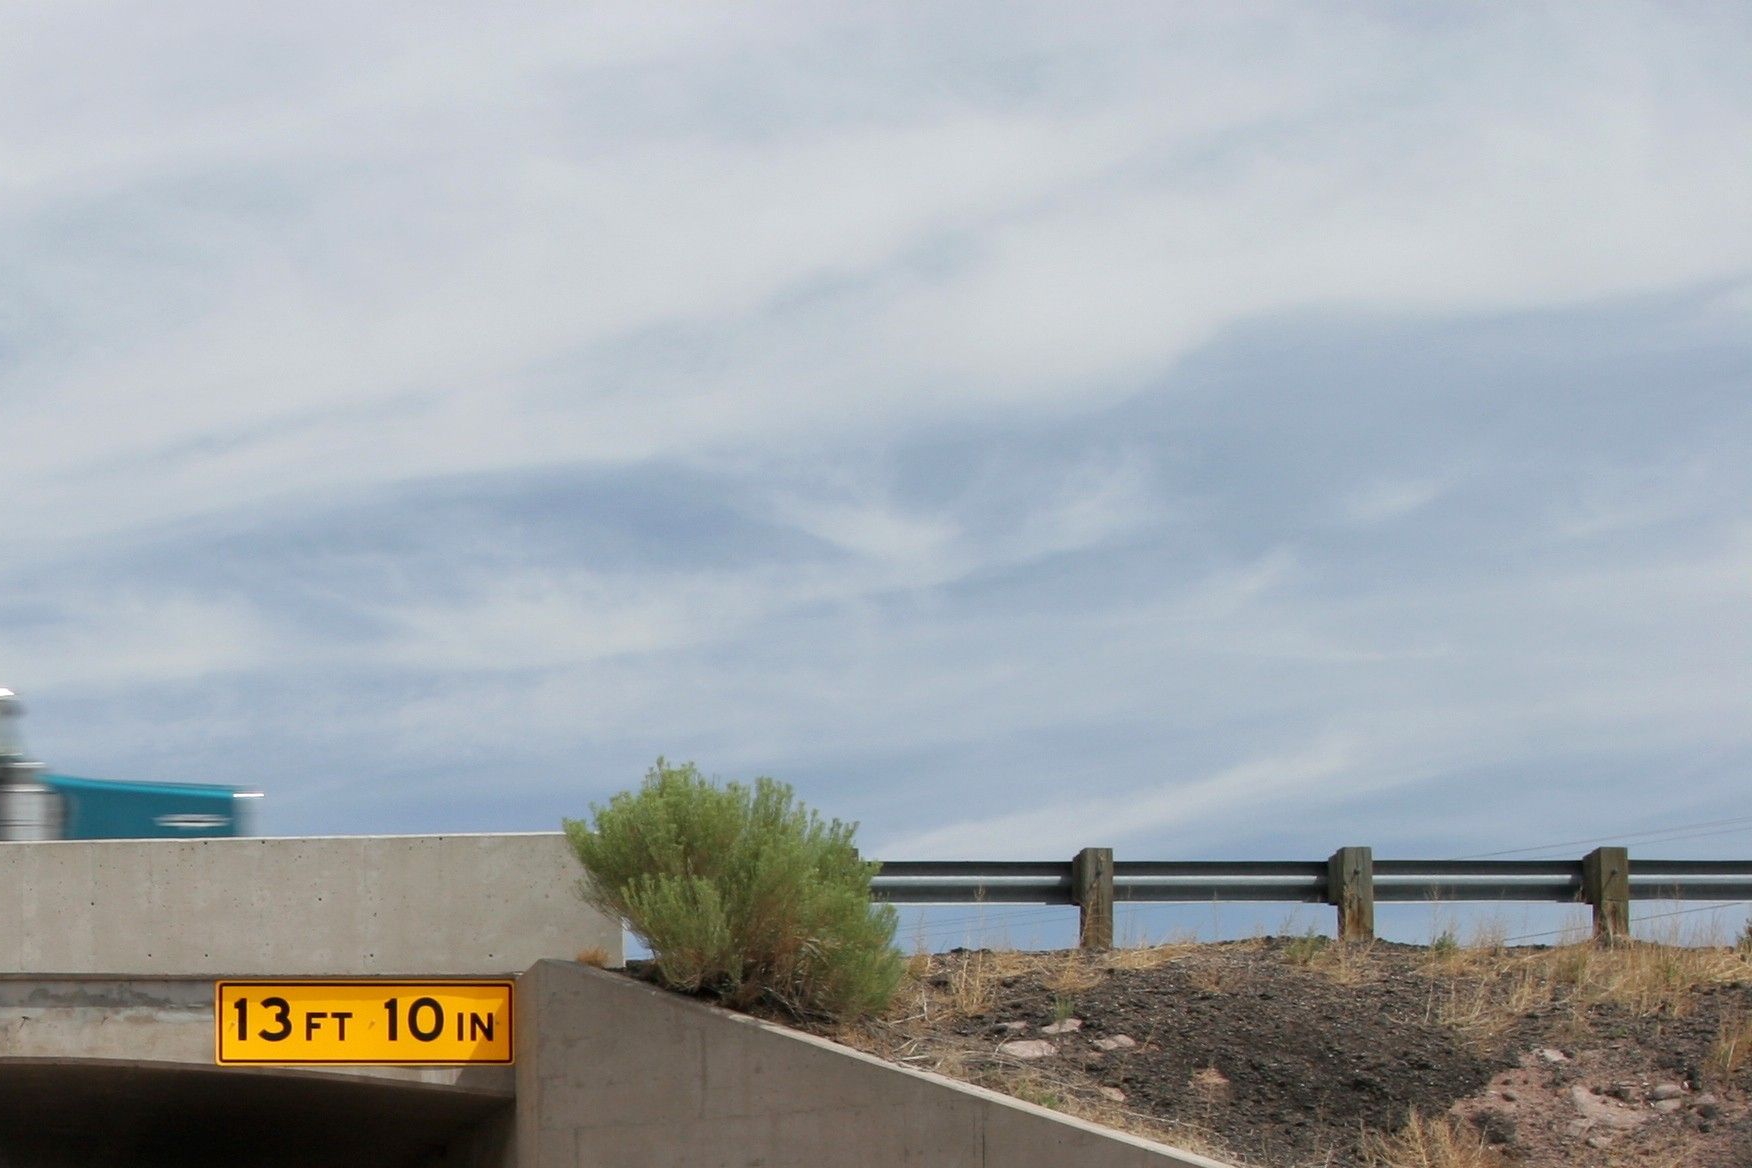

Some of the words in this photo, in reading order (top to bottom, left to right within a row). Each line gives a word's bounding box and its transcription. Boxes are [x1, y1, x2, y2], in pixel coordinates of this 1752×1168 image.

[234, 996, 293, 1042] 13
[305, 1012, 353, 1042] FT
[384, 996, 445, 1042] 10
[457, 1012, 494, 1042] IN
